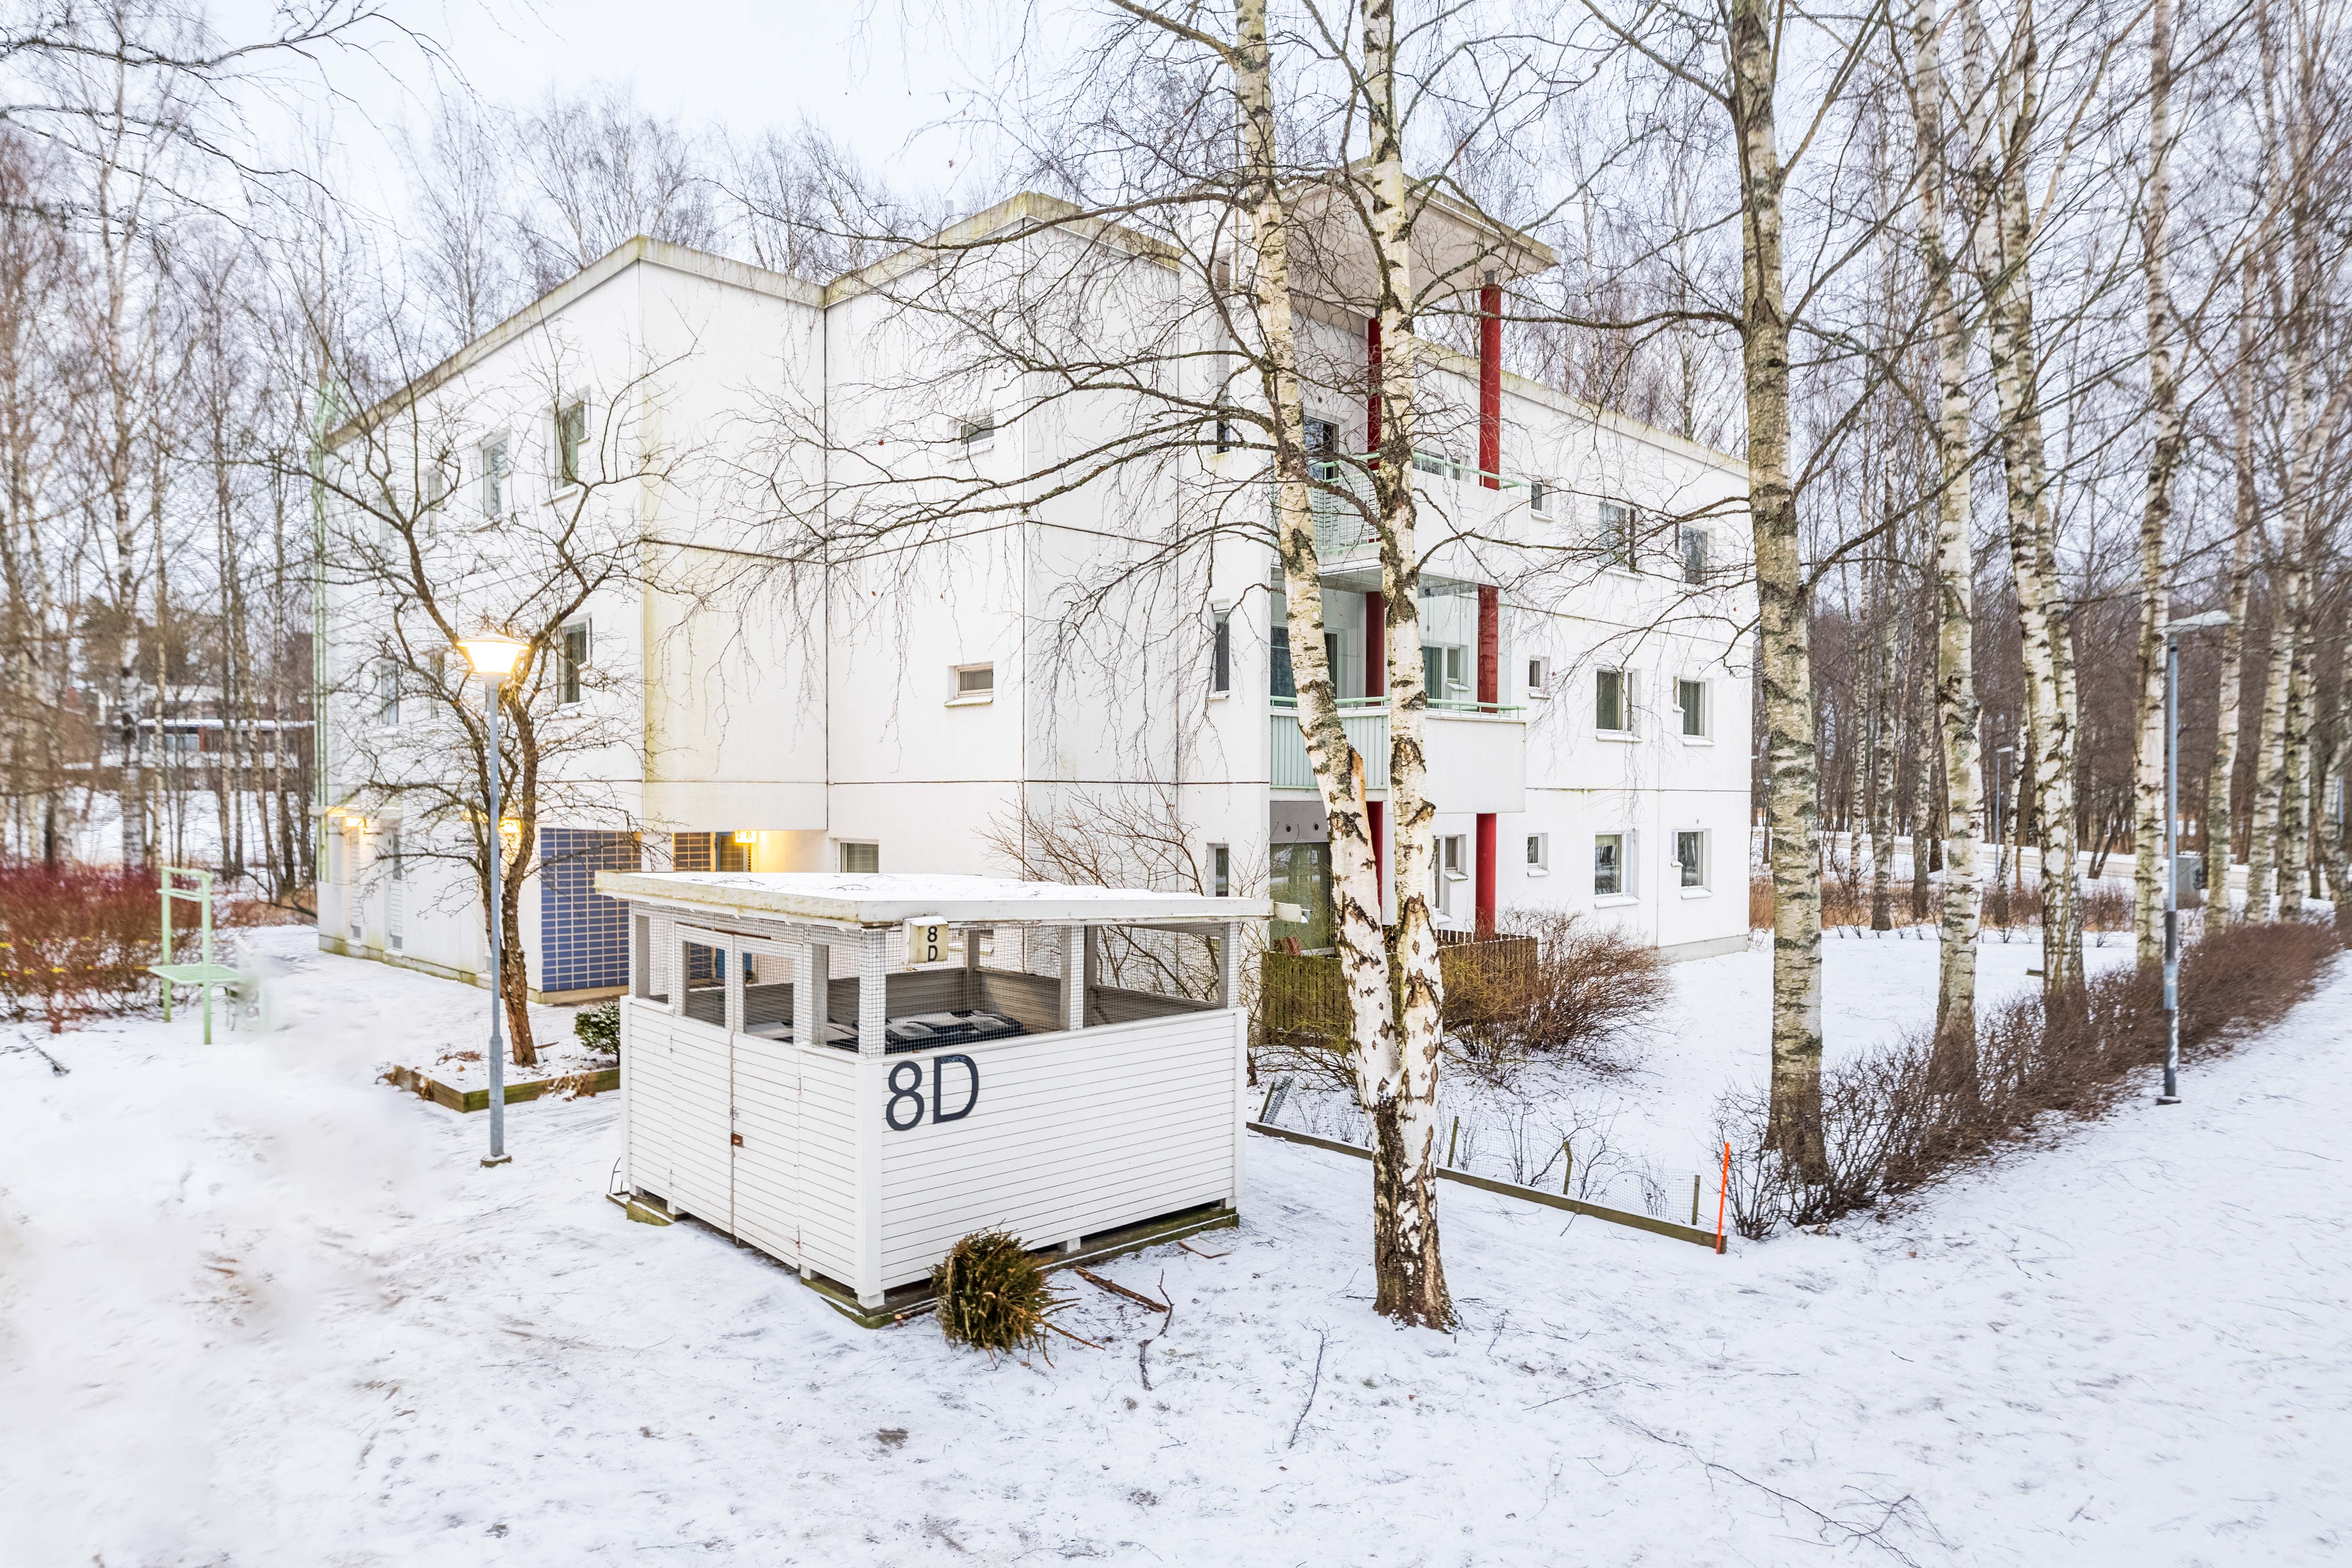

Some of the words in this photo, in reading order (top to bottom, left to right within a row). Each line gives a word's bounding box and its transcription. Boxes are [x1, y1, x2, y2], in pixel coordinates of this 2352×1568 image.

[927, 926, 938, 943] 8
[928, 945, 938, 962] D
[886, 1054, 979, 1131] 8D
